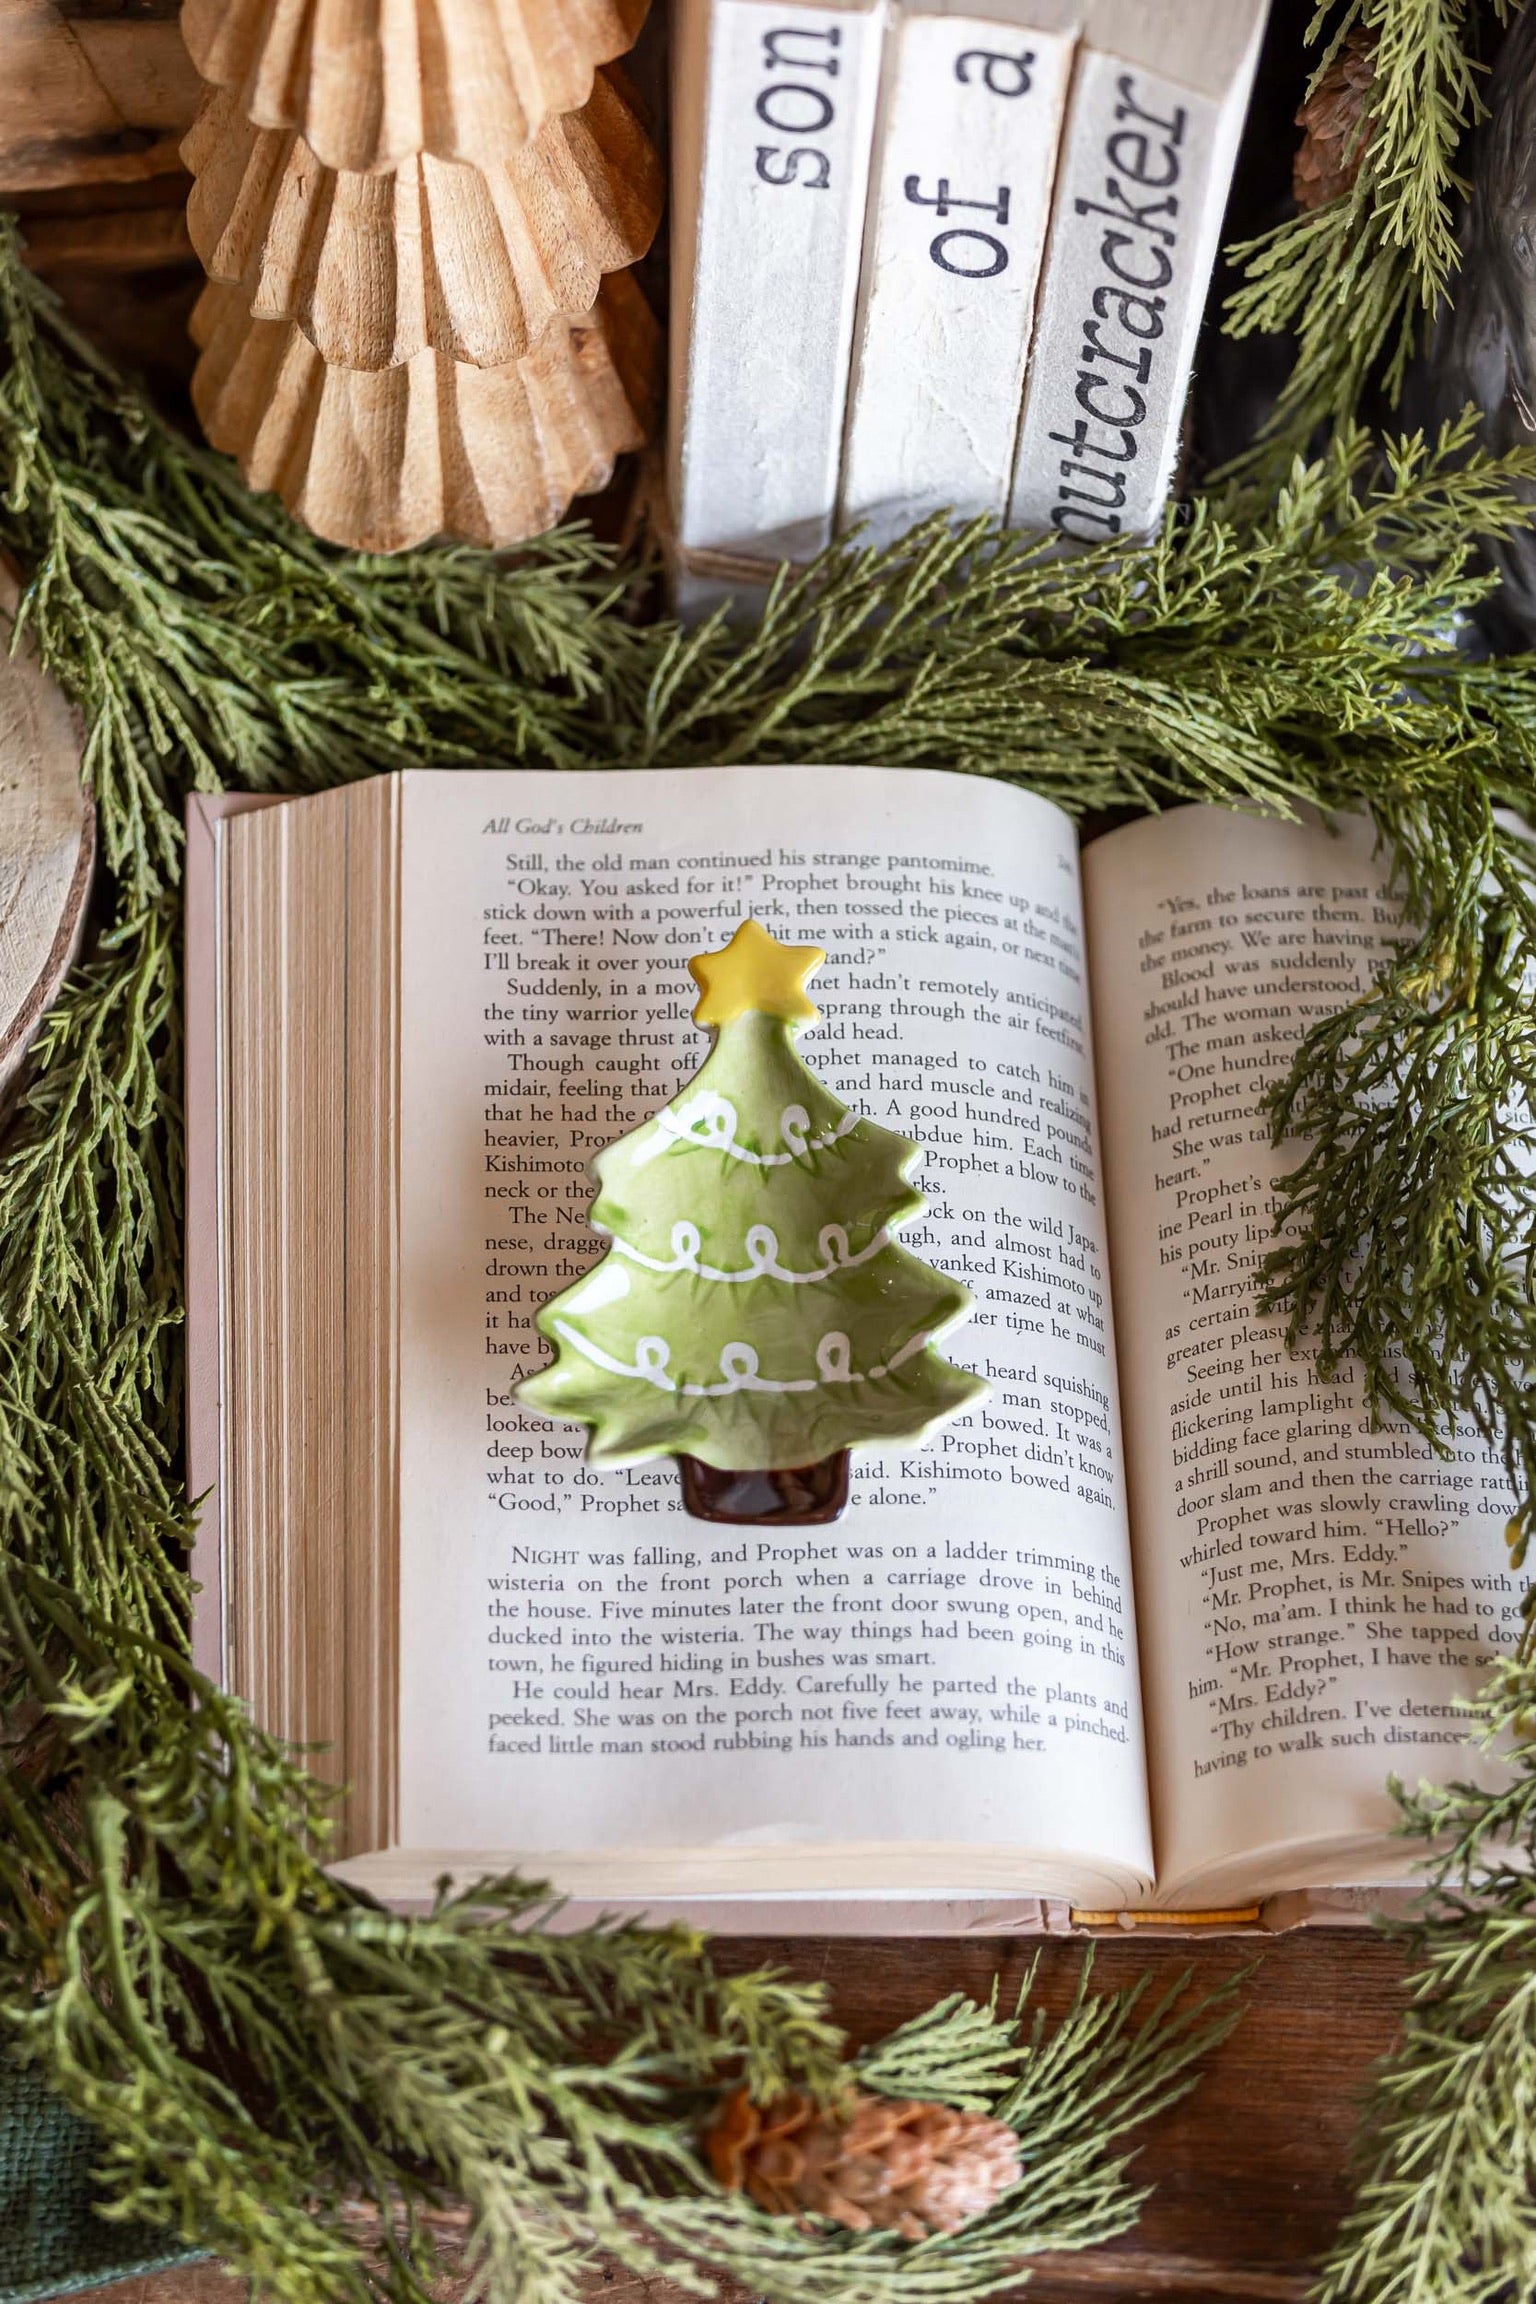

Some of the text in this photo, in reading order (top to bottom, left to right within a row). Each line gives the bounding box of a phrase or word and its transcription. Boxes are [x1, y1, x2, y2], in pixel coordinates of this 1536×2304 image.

[755, 25, 841, 190] son
[904, 47, 1037, 278] of a
[1050, 74, 1187, 543] nutcracker
[483, 818, 509, 834] All
[570, 818, 643, 834] Children
[506, 850, 995, 877] Still, the old man continued his strange pantomime.
[581, 879, 618, 896] You
[627, 878, 678, 895] asked
[687, 877, 712, 893] for
[763, 873, 838, 893] Prophet
[847, 873, 921, 893] brought
[483, 898, 998, 927] stick down with powerful then tossed pieces
[483, 929, 523, 945] feet.
[613, 928, 658, 945] Now
[798, 927, 826, 939] me
[833, 923, 873, 940] with
[896, 925, 939, 943] stick
[945, 934, 996, 952] again,
[517, 953, 638, 971] break over
[1270, 952, 1356, 972] suddenly
[507, 978, 601, 998] Suddenly,
[610, 978, 627, 995] in
[919, 979, 998, 1002] remotely
[522, 1001, 965, 1024] tiny warrior through
[1224, 1007, 1291, 1023] woman
[484, 1023, 903, 1049] with savage thrust head.
[508, 1052, 1041, 1083] Though caught managed catch
[484, 1073, 995, 1100] midair, feeling hard muscle
[1169, 1082, 1240, 1110] Prophet
[485, 1102, 1040, 1132] that had good hundred
[484, 1128, 1062, 1163] heavier, him. Each
[484, 1151, 1059, 1185] Kishimoto Prophet blow
[484, 1181, 595, 1198] neck the
[509, 1207, 1062, 1238] The wild
[1187, 1202, 1232, 1231] Pearl
[485, 1233, 1051, 1258] nese, almost
[486, 1259, 1084, 1295] drown Kishimoto
[1189, 1304, 1250, 1333] certain
[486, 1336, 530, 1355] have
[987, 1359, 1036, 1383] heard
[1186, 1349, 1282, 1383] Seeing her
[1261, 1393, 1353, 1422] lamplight
[486, 1441, 533, 1462] deep
[541, 1441, 582, 1459] bow
[942, 1435, 1017, 1457] Prophet
[1234, 1443, 1433, 1474] sound, stumbled
[486, 1460, 1069, 1493] what do. Kishimoto bowed
[582, 1493, 661, 1517] Prophet
[1177, 1471, 1473, 1518] door carriage
[1196, 1495, 1470, 1537] Prophet slowly crawling
[1250, 1521, 1316, 1549] toward
[1324, 1521, 1367, 1539] him.
[512, 1541, 1094, 1580] NIGHT was falling, and ladder trimming
[1291, 1549, 1335, 1567] Mrs.
[488, 1569, 1033, 1593] wisteria front porch carriage drove
[1249, 1570, 1464, 1603] Prophet, Mr. Snipes
[527, 1594, 938, 1619] house. Five minutes later door
[1345, 1596, 1468, 1616] think had
[488, 1620, 912, 1645] ducked into wisteria. things
[1366, 1621, 1402, 1640] She
[1411, 1622, 1478, 1645] tapped
[488, 1650, 935, 1676] town, figured hiding smart.
[1388, 1648, 1432, 1667] have
[553, 1677, 786, 1699] could hear Mrs. Eddy.
[573, 1703, 793, 1726] She porch
[1261, 1707, 1347, 1731] children.
